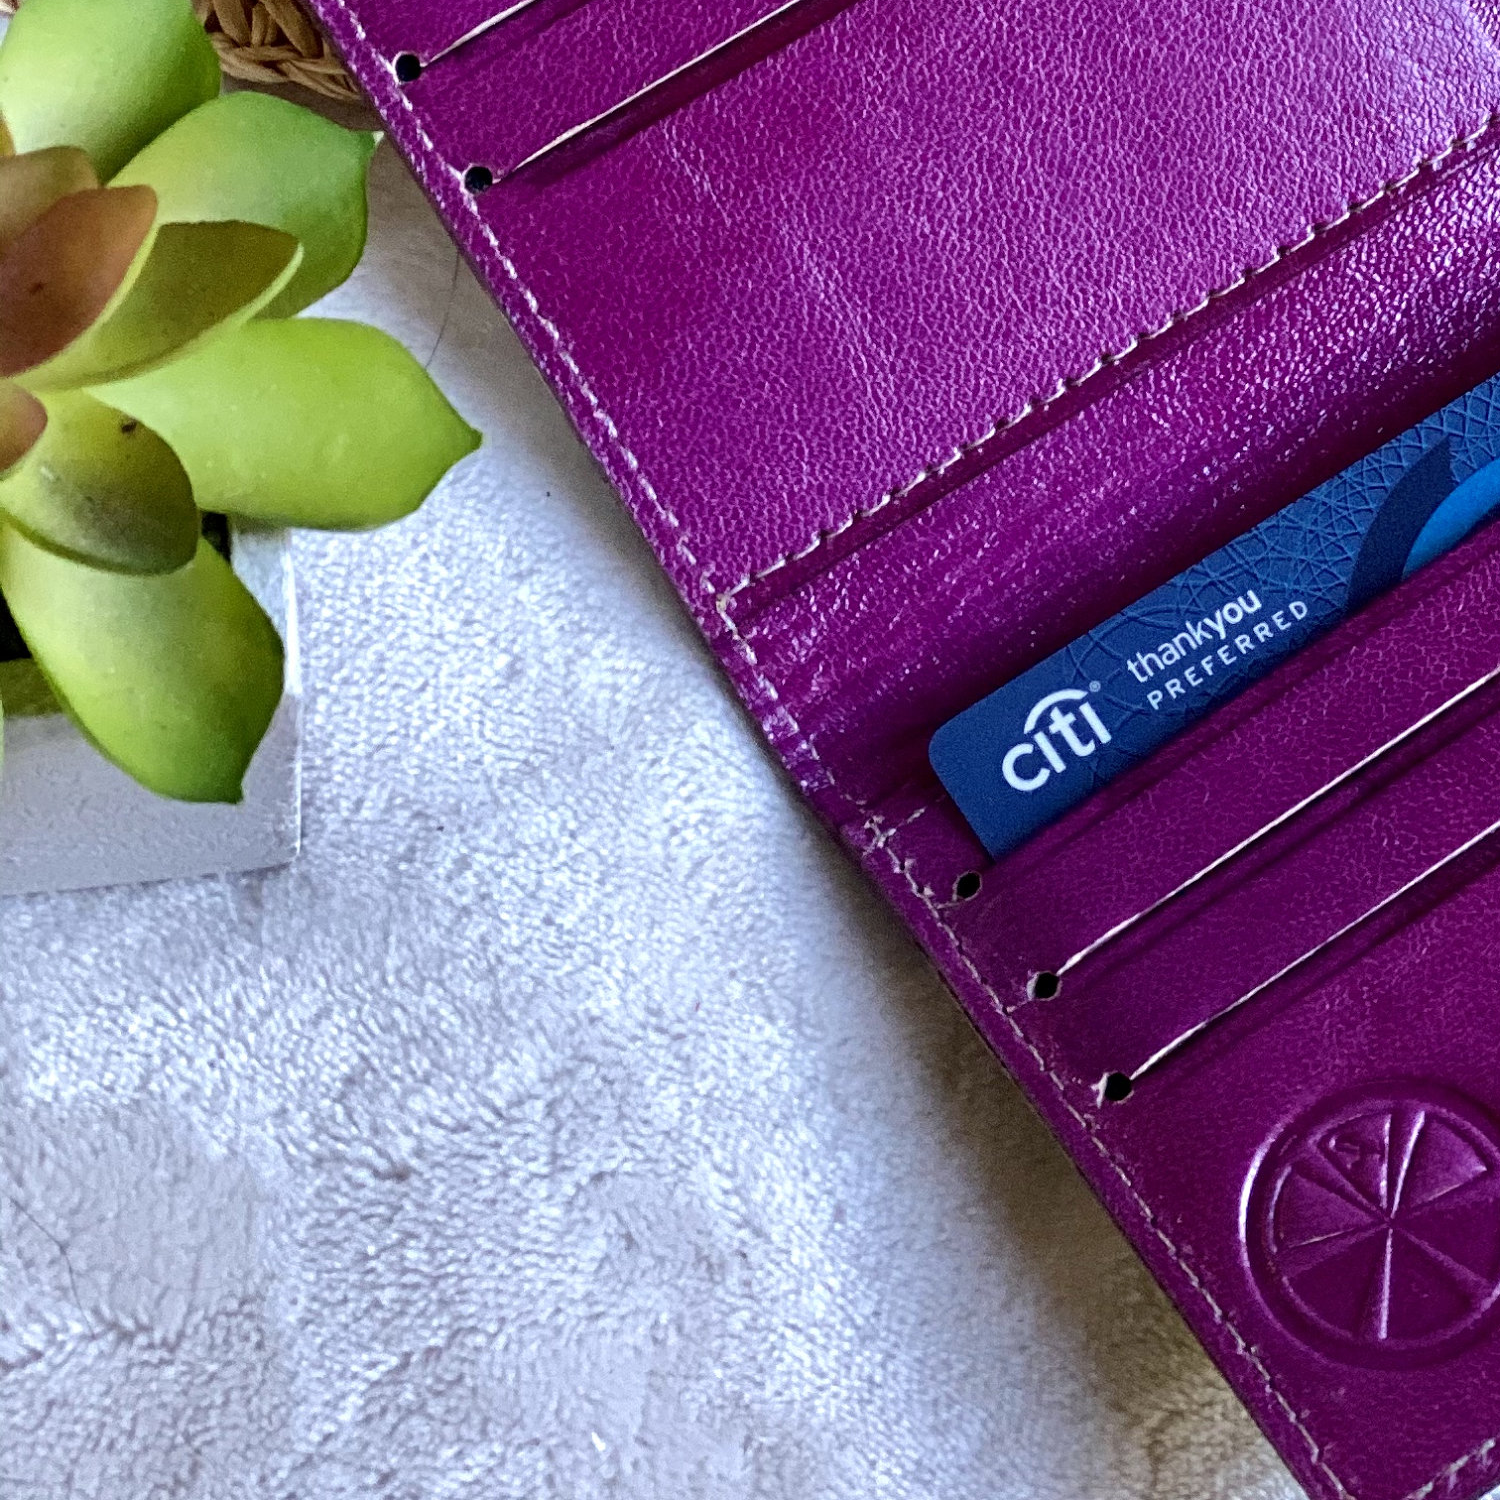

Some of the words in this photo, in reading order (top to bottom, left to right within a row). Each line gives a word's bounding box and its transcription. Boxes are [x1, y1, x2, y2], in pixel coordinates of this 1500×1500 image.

[1127, 590, 1262, 683] thankyou
[1147, 601, 1309, 710] PREFERRED
[1002, 689, 1112, 791] citi
